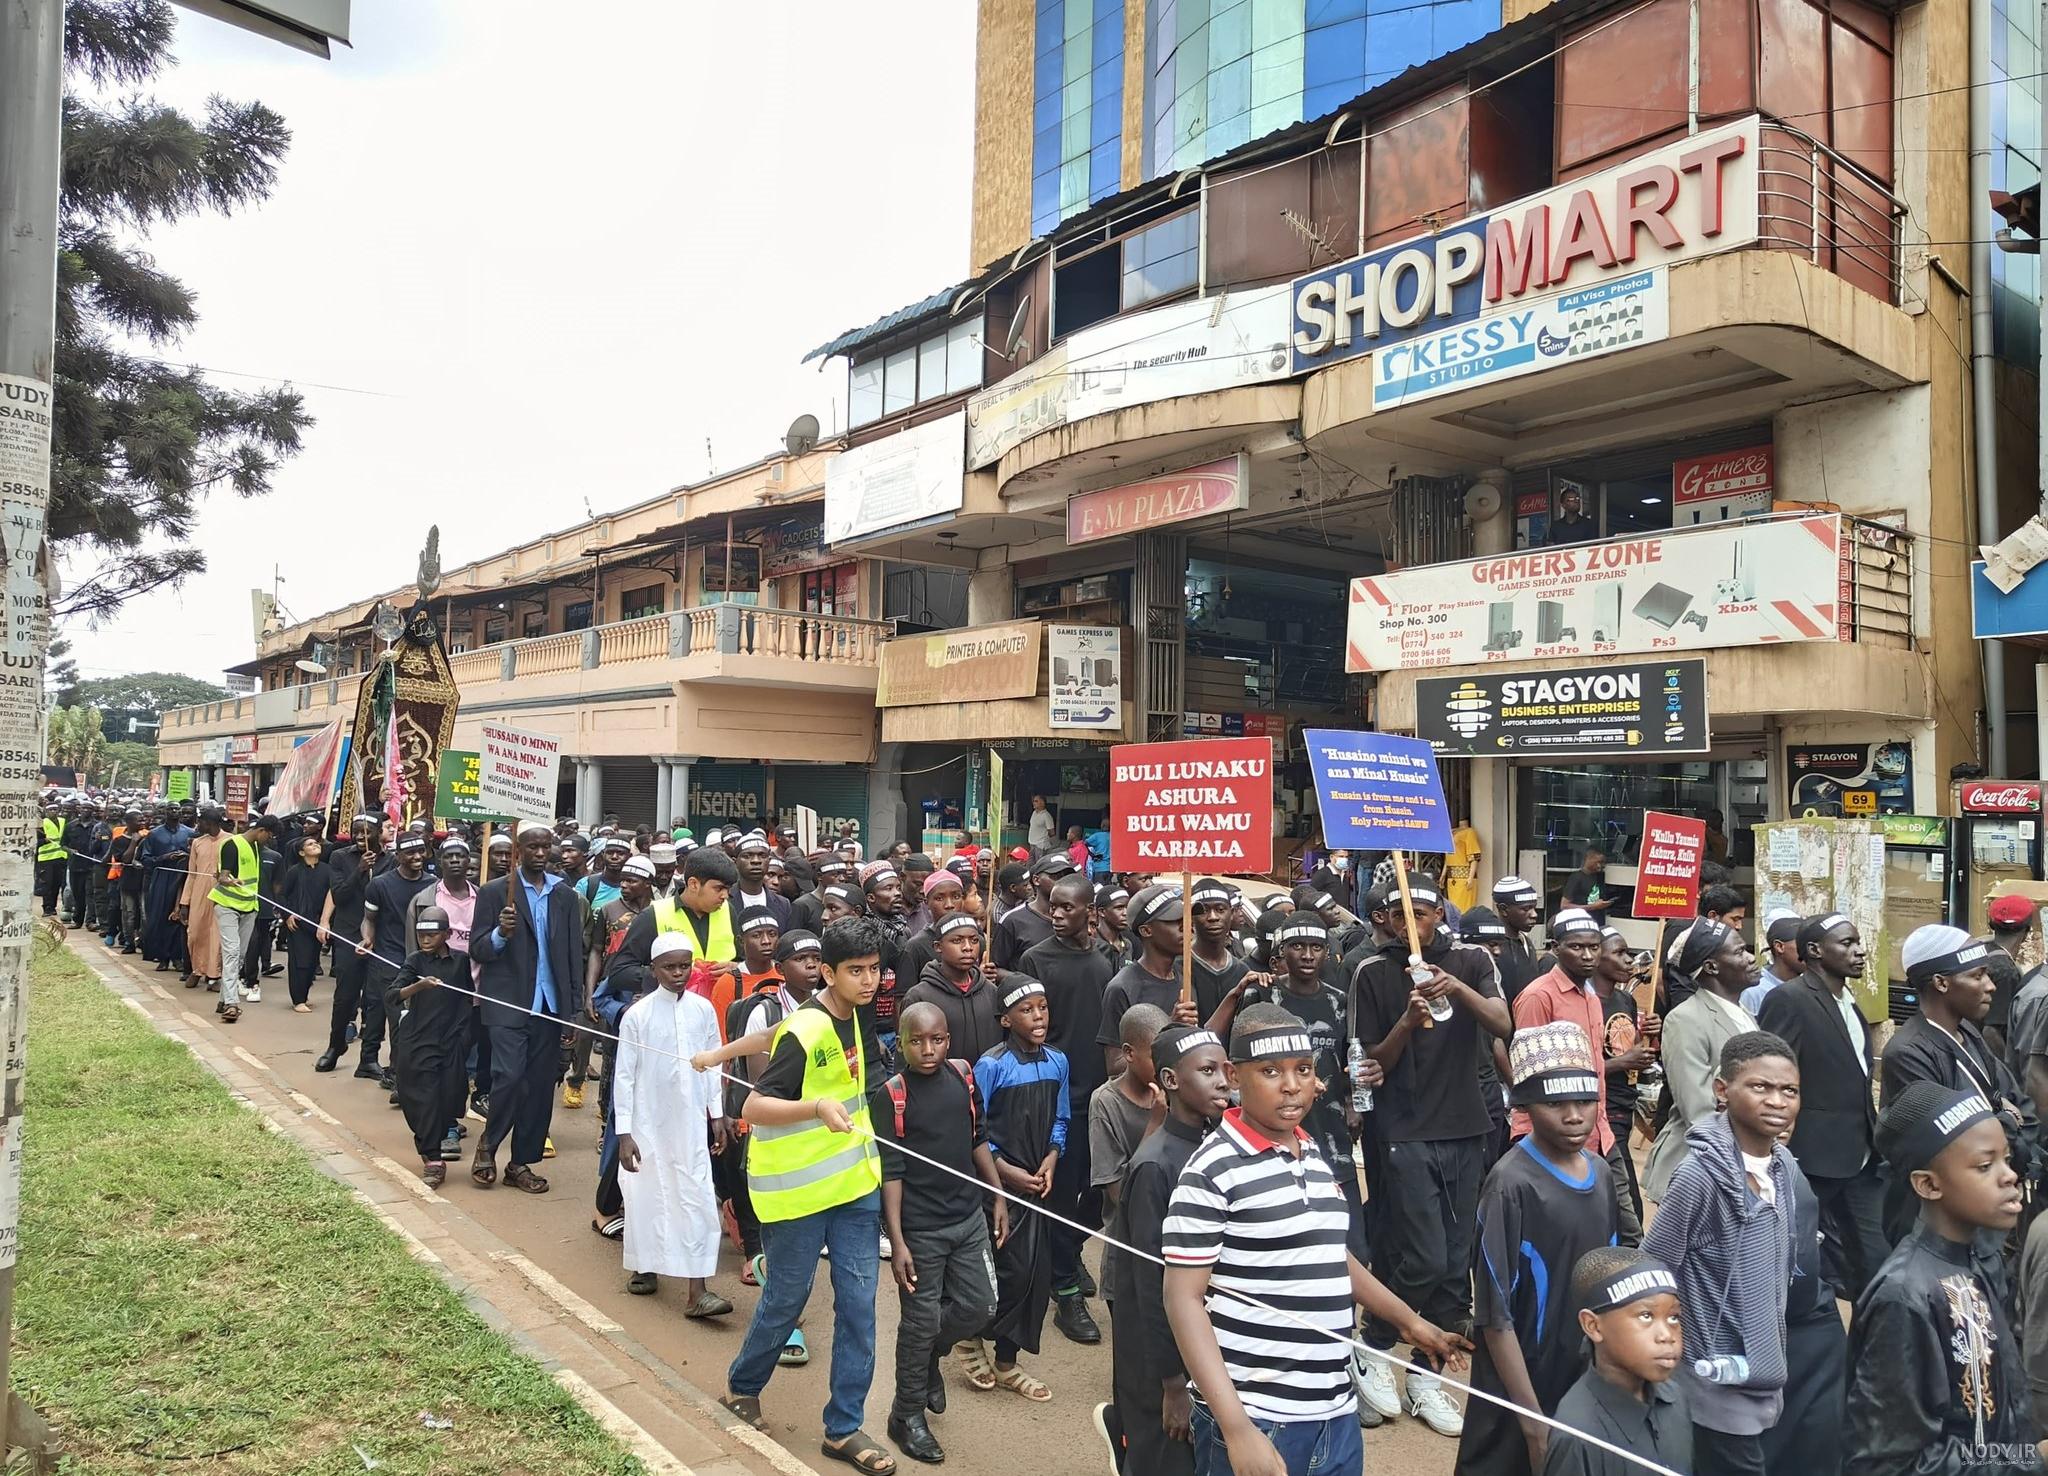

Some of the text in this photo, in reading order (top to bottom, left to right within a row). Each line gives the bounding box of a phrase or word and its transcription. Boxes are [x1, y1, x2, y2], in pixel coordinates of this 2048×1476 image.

[1563, 276, 1649, 308] All Visa Photos
[1412, 310, 1534, 373] KESSY
[1540, 334, 1551, 347] 5
[1133, 345, 1207, 370] The security Hub
[1429, 357, 1494, 385] STUDIO
[1708, 475, 1763, 491] ZONE
[1134, 480, 1206, 525] PLAZA
[1472, 539, 1663, 585] GAMERS ZONE
[1497, 569, 1628, 592] GAMES SHOP AND REPAIRS
[1536, 587, 1576, 600] CENTRE
[1401, 603, 1433, 616] Floor
[1718, 602, 1758, 614] Xbox
[1379, 613, 1448, 630] Shop No. 300
[1078, 629, 1103, 637] EXPRESS
[1652, 635, 1677, 648] Ps3
[946, 634, 1026, 660] PRINTER & COMPUTER
[1487, 650, 1507, 661] Ps4
[1533, 644, 1580, 657] Ps4 Pro
[1593, 641, 1617, 653] Ps5
[1501, 672, 1640, 705] STAGYON
[1501, 700, 1641, 717] BUSINESS ENTERPRISES
[1501, 719, 1529, 727] LAPTOPS,
[1529, 717, 1561, 726] DESKTOPS,
[1561, 716, 1592, 725] PRINTERS
[1597, 714, 1641, 724] ACCESSORIES
[521, 735, 528, 746] O
[529, 737, 558, 753] MINNI
[982, 739, 1015, 749] Hisense
[1032, 738, 1069, 748] Hisense
[488, 743, 549, 768] WA ANA MINAL
[1379, 751, 1411, 766] minni
[1411, 757, 1428, 768] wa
[1811, 752, 1858, 762] STAGYON
[1116, 759, 1266, 782] BULI LUNAKU
[1328, 768, 1351, 779] ana
[1351, 767, 1388, 781] Minal
[482, 784, 494, 794] AND
[497, 786, 507, 797] AM
[488, 773, 511, 787] HUSSAIN
[517, 781, 536, 793] FROM
[536, 786, 546, 796] ME
[1144, 786, 1237, 807] ASHURA
[1330, 790, 1362, 801] Husain
[1363, 791, 1371, 801] is
[1372, 792, 1391, 803] from
[1392, 795, 1404, 803] me
[1405, 795, 1419, 804] and
[1424, 797, 1436, 806] am
[1852, 794, 1868, 805] 69
[1969, 787, 2029, 808] Coca-Cola
[459, 805, 470, 813] to
[1363, 804, 1384, 814] from
[1127, 813, 1252, 832] BULI WAMU
[1351, 816, 1372, 828] Holy
[1372, 817, 1404, 829] Prophet
[1137, 839, 1245, 858] KARBALA
[1250, 1036, 1291, 1057] LABBAYK
[1543, 1077, 1584, 1095] LABBAYK
[1934, 1095, 1984, 1136] LABBAYK
[1607, 1271, 1657, 1304] LABBAYK
